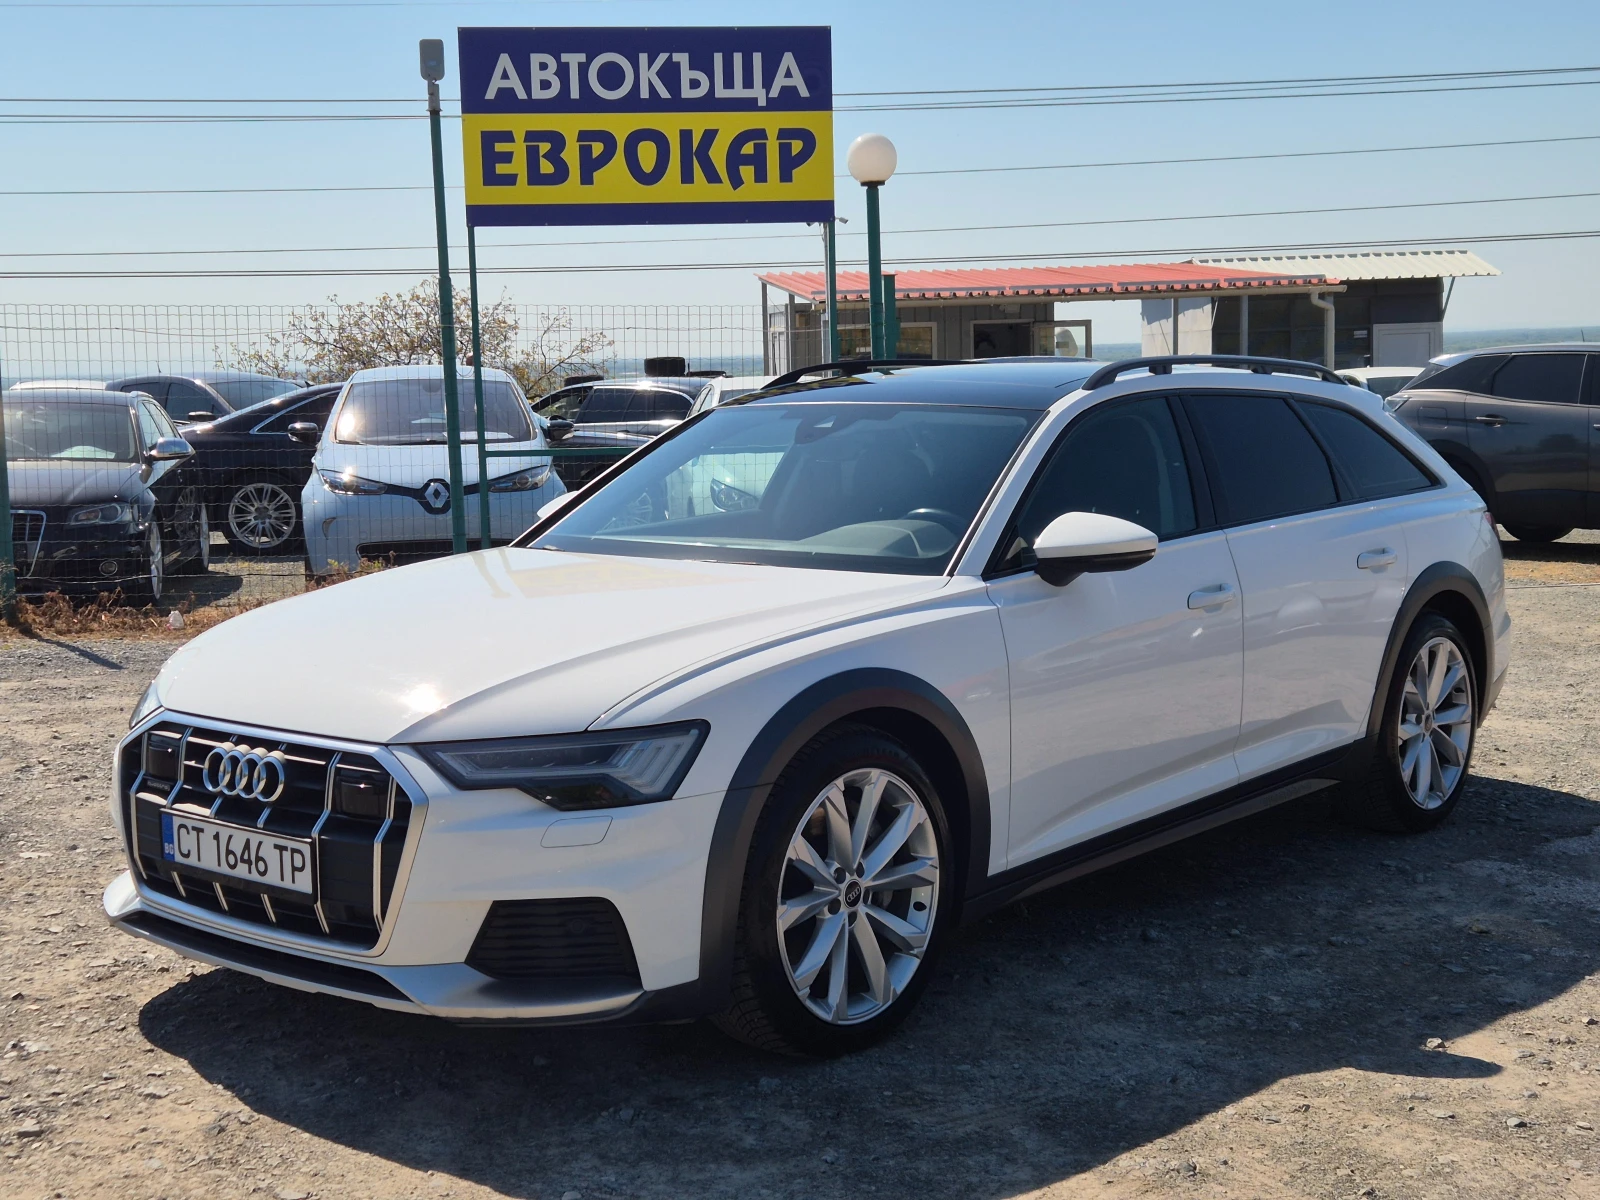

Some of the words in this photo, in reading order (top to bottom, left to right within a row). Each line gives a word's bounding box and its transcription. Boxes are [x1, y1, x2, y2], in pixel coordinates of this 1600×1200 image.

[484, 52, 810, 106] АВТОКЪЩА
[480, 127, 816, 191] ЕВРОКАР
[164, 843, 174, 855] BG
[176, 823, 205, 862] CT
[213, 831, 268, 877] 1646
[273, 844, 306, 884] TP
